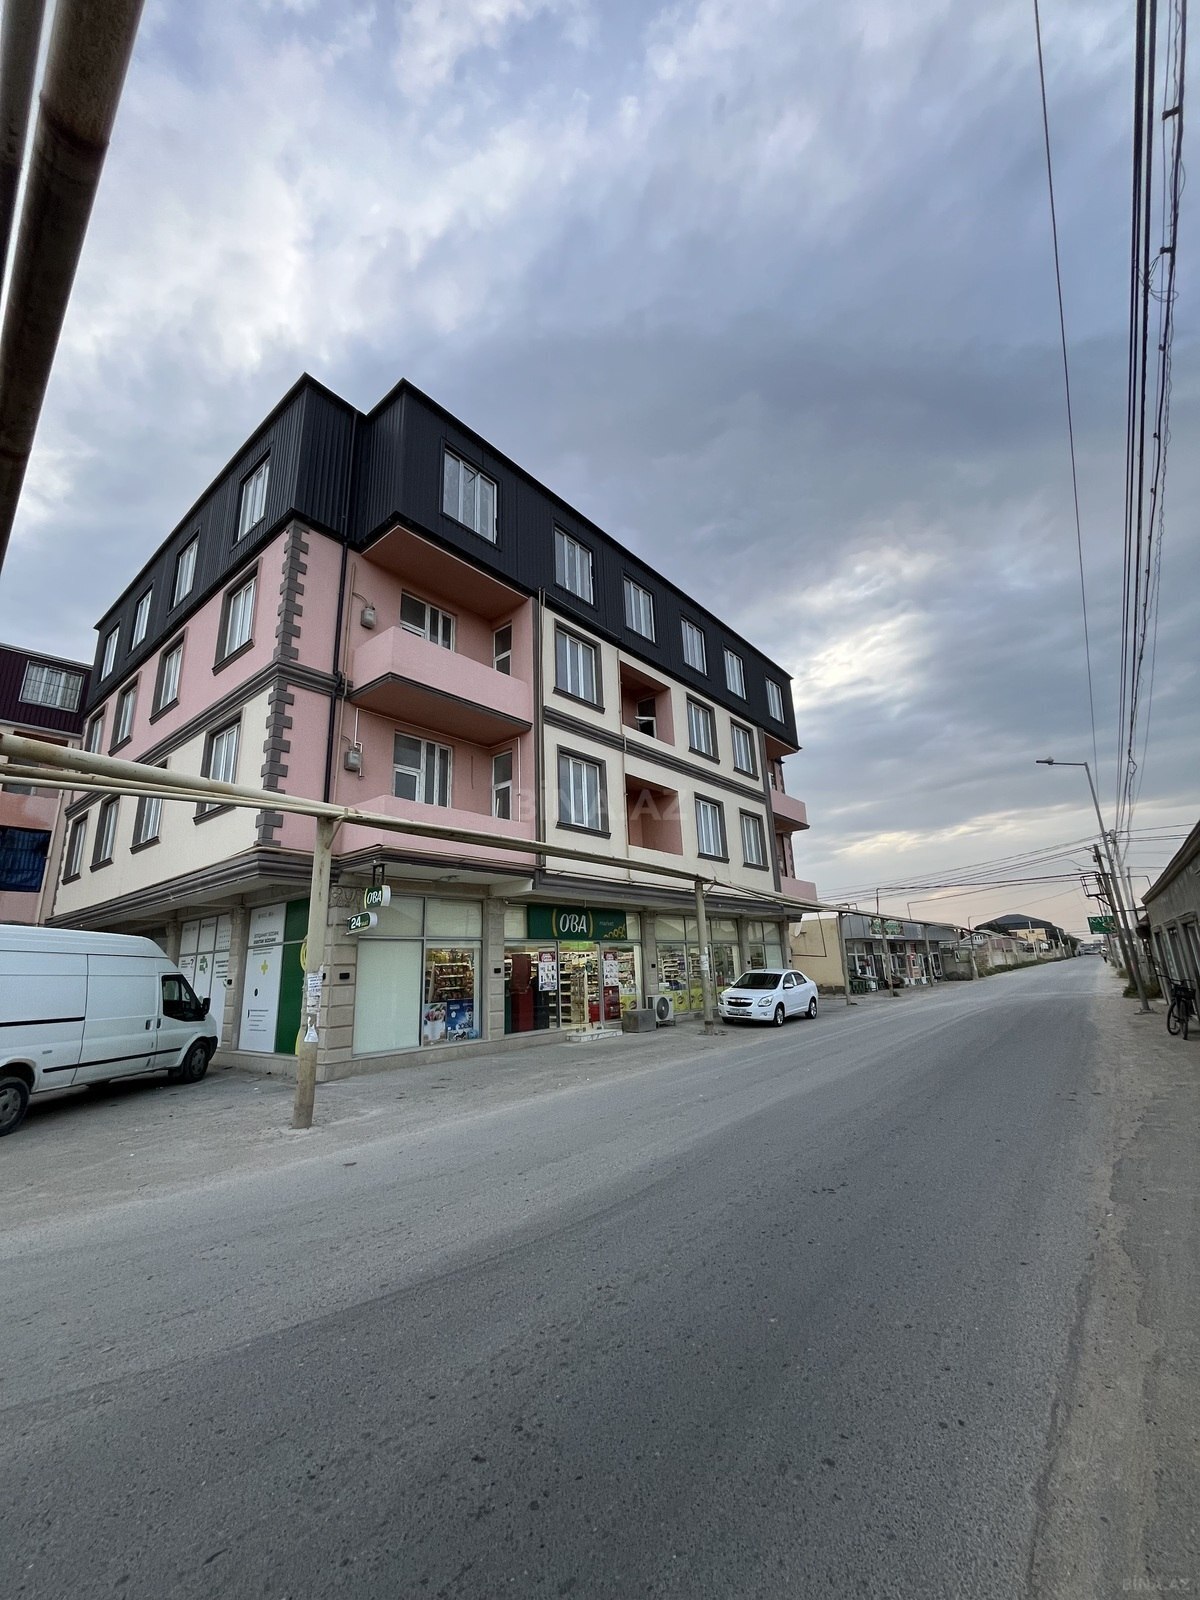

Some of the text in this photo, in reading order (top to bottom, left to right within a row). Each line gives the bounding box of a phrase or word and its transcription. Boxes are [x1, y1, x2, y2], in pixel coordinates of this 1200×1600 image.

[367, 890, 382, 904] OBA
[350, 916, 361, 929] 24
[560, 913, 587, 933] OBA
